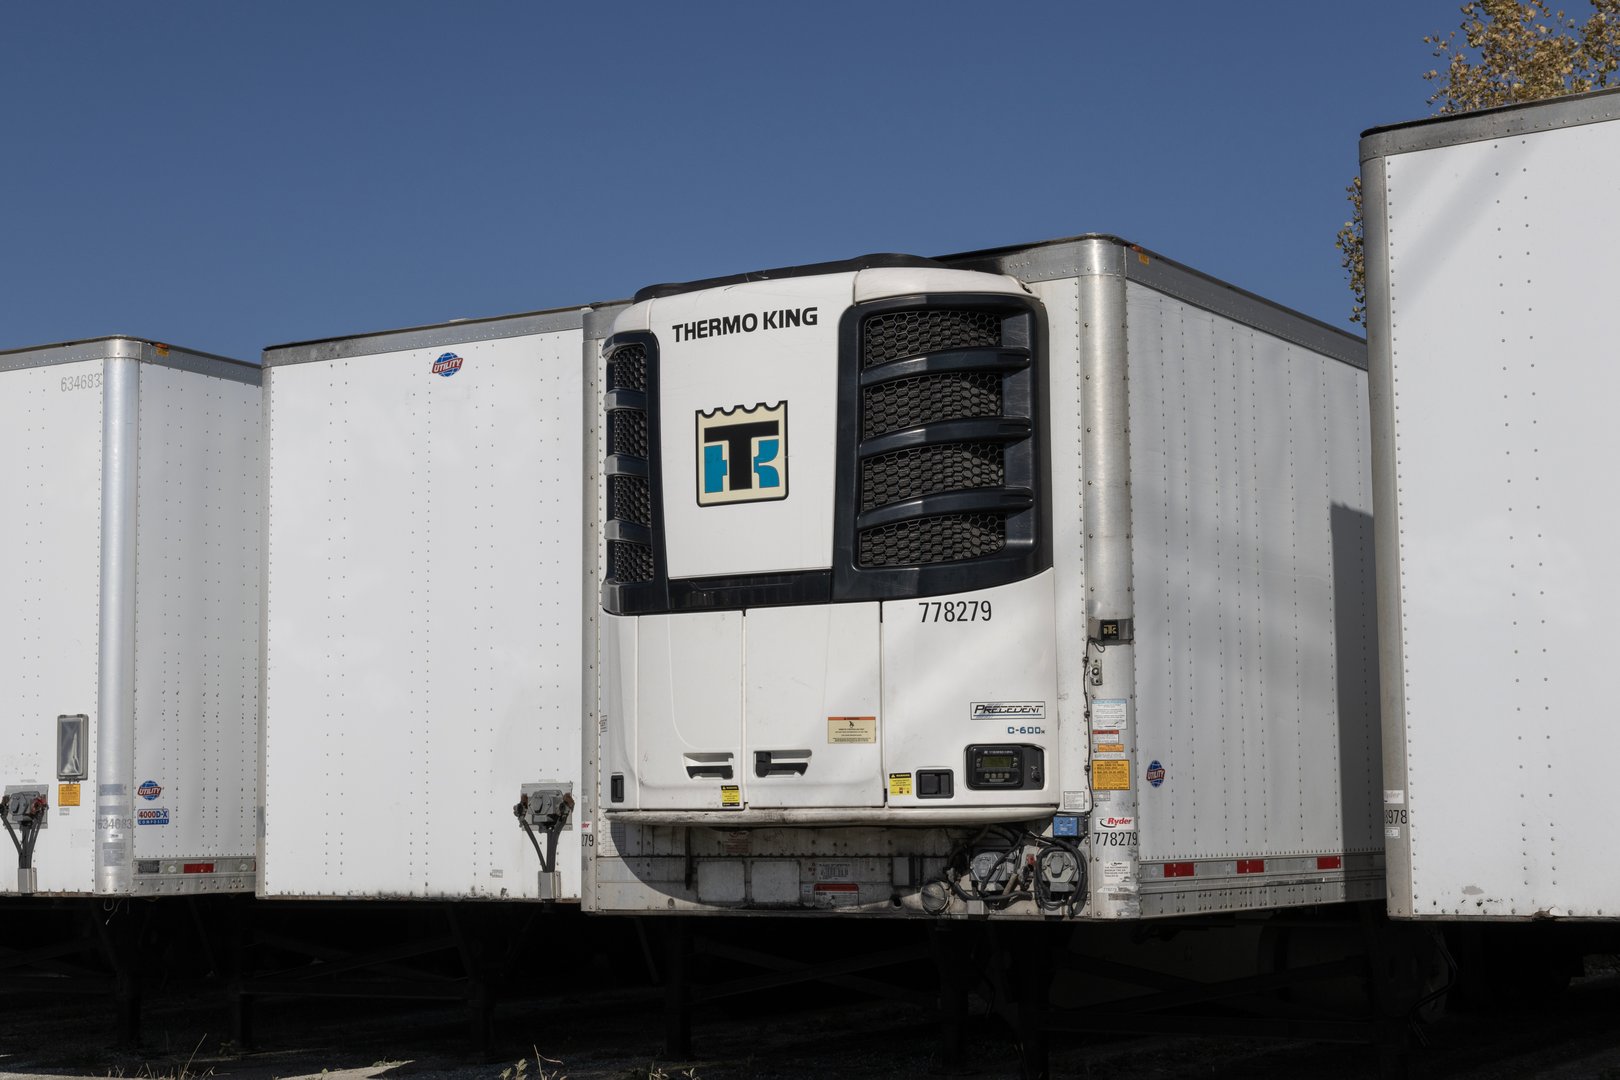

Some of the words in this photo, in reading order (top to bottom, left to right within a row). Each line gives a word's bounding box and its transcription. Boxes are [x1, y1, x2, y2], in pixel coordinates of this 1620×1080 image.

[672, 312, 758, 342] THERMO
[763, 306, 818, 330] KING
[433, 359, 462, 372] UTILITY
[919, 600, 992, 622] 778279
[974, 704, 1044, 714] PRECEDENT
[1147, 770, 1165, 780] UTILITY
[139, 787, 161, 795] UTILITY
[98, 818, 132, 829] 634683
[1107, 817, 1132, 826] Ryder
[1094, 831, 1138, 847] 778279
